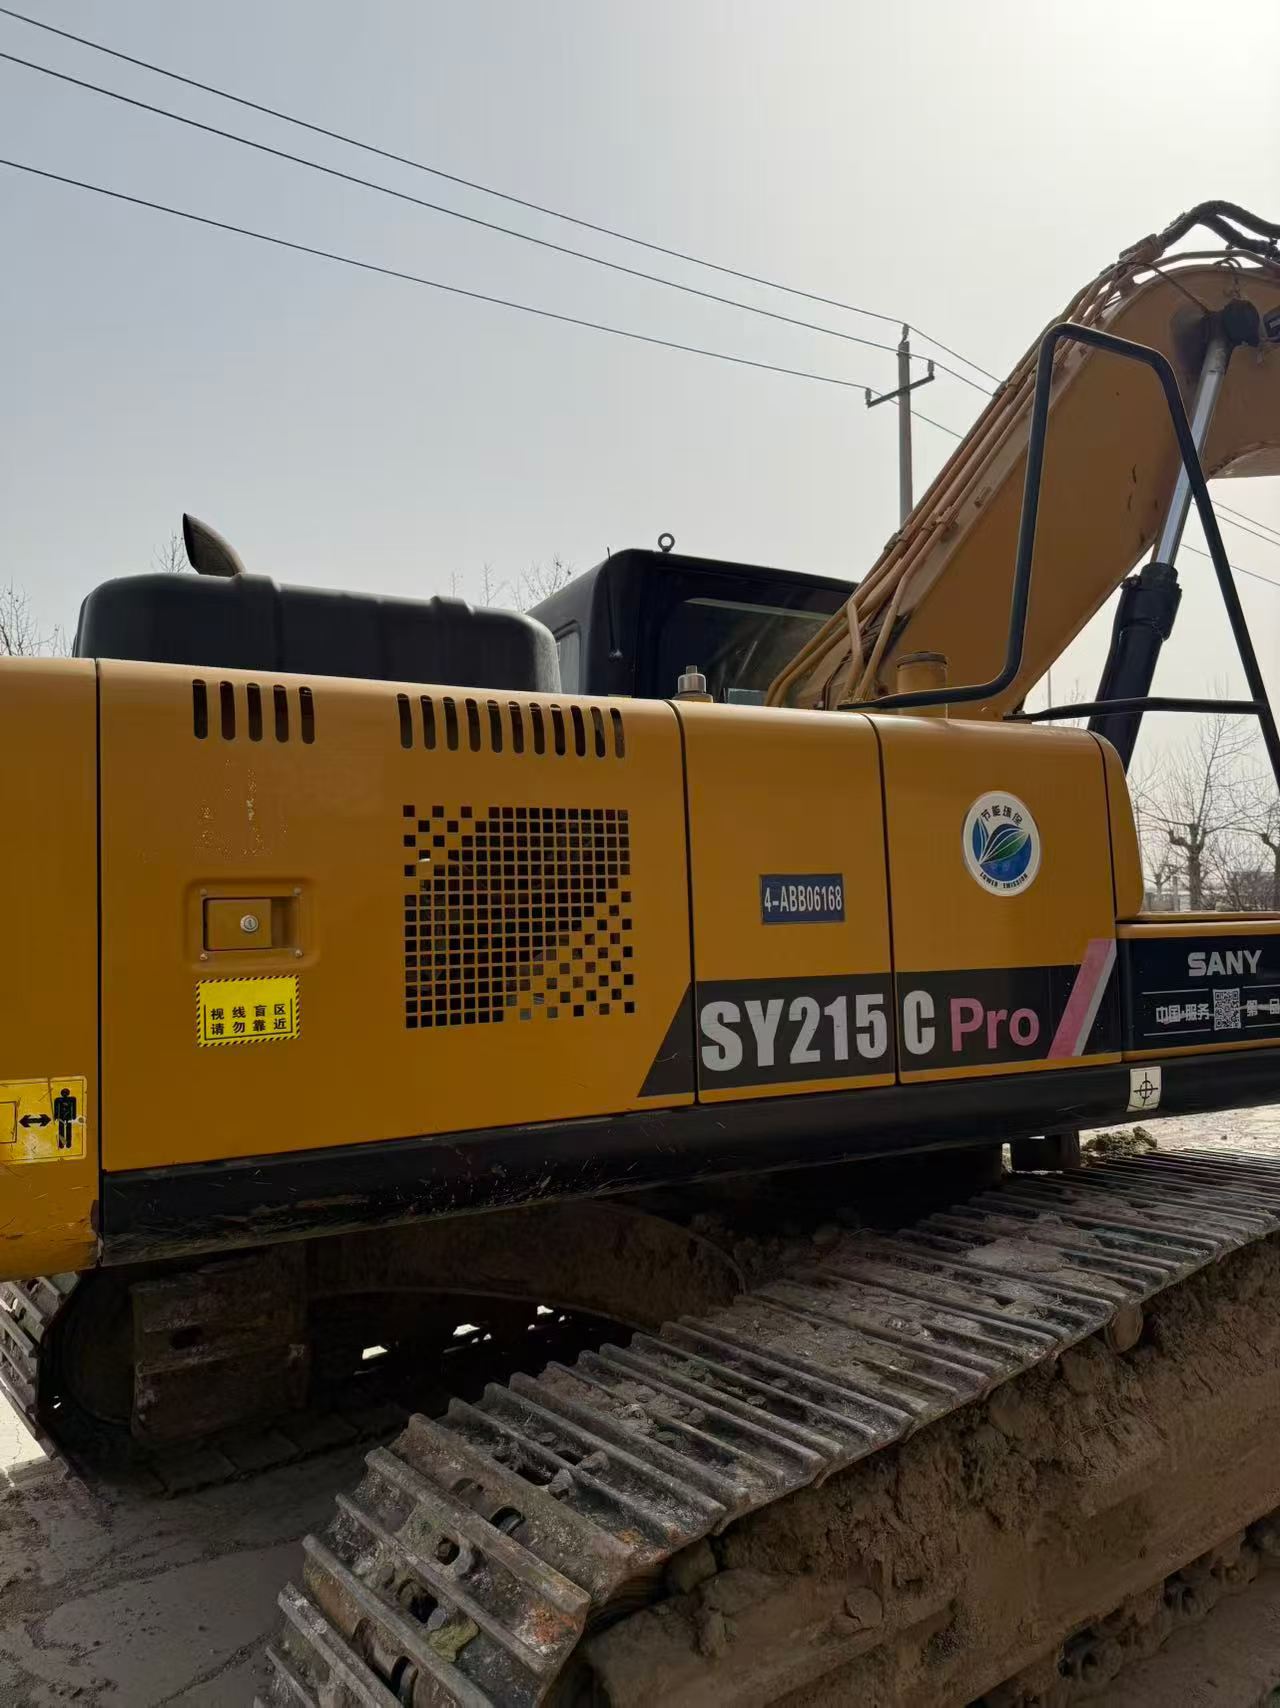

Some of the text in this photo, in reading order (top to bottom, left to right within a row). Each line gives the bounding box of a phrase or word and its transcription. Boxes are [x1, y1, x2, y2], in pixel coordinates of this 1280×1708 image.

[979, 871, 1028, 889] LOWER EMISSION
[764, 885, 842, 912] 4-ABB06168
[1187, 950, 1262, 976] SANY
[211, 1003, 286, 1020] 视线盲区
[211, 1018, 287, 1035] 请勿靠近
[950, 997, 1039, 1052] Pro
